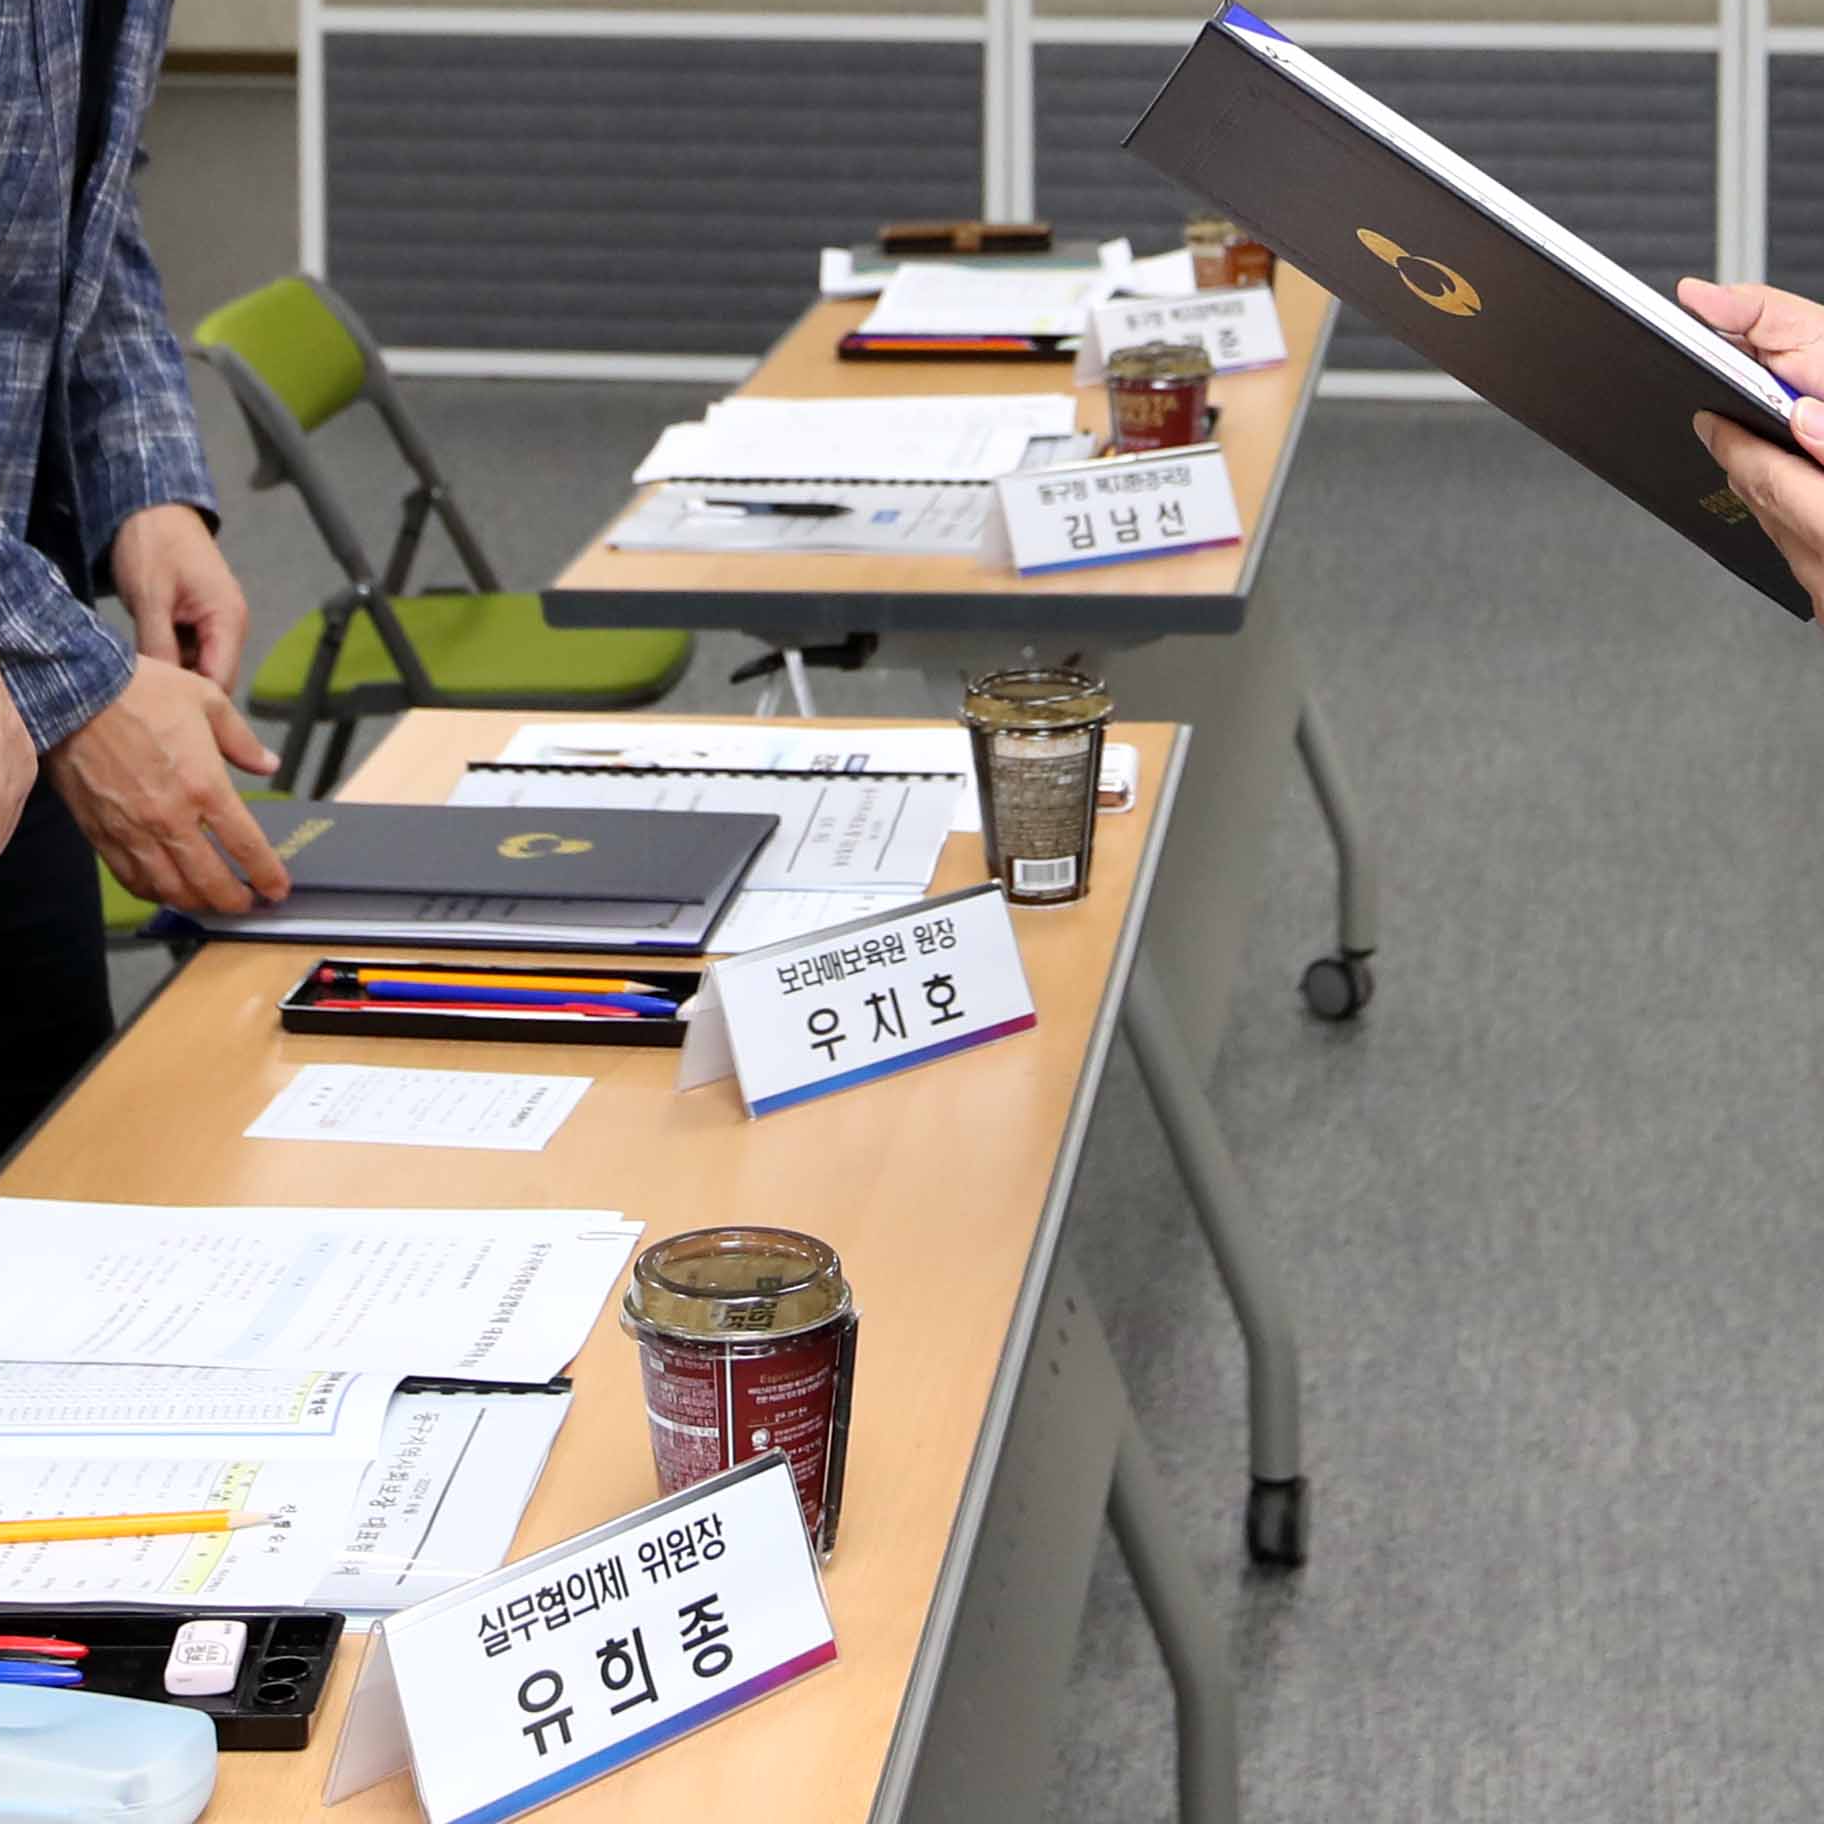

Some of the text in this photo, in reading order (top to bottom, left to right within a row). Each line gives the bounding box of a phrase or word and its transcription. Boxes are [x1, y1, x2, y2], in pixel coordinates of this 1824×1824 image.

[1038, 480, 1087, 504] 동구청
[778, 918, 957, 995] 보라매보육원 원장
[477, 1513, 726, 1658] 실무협의체 위원장
